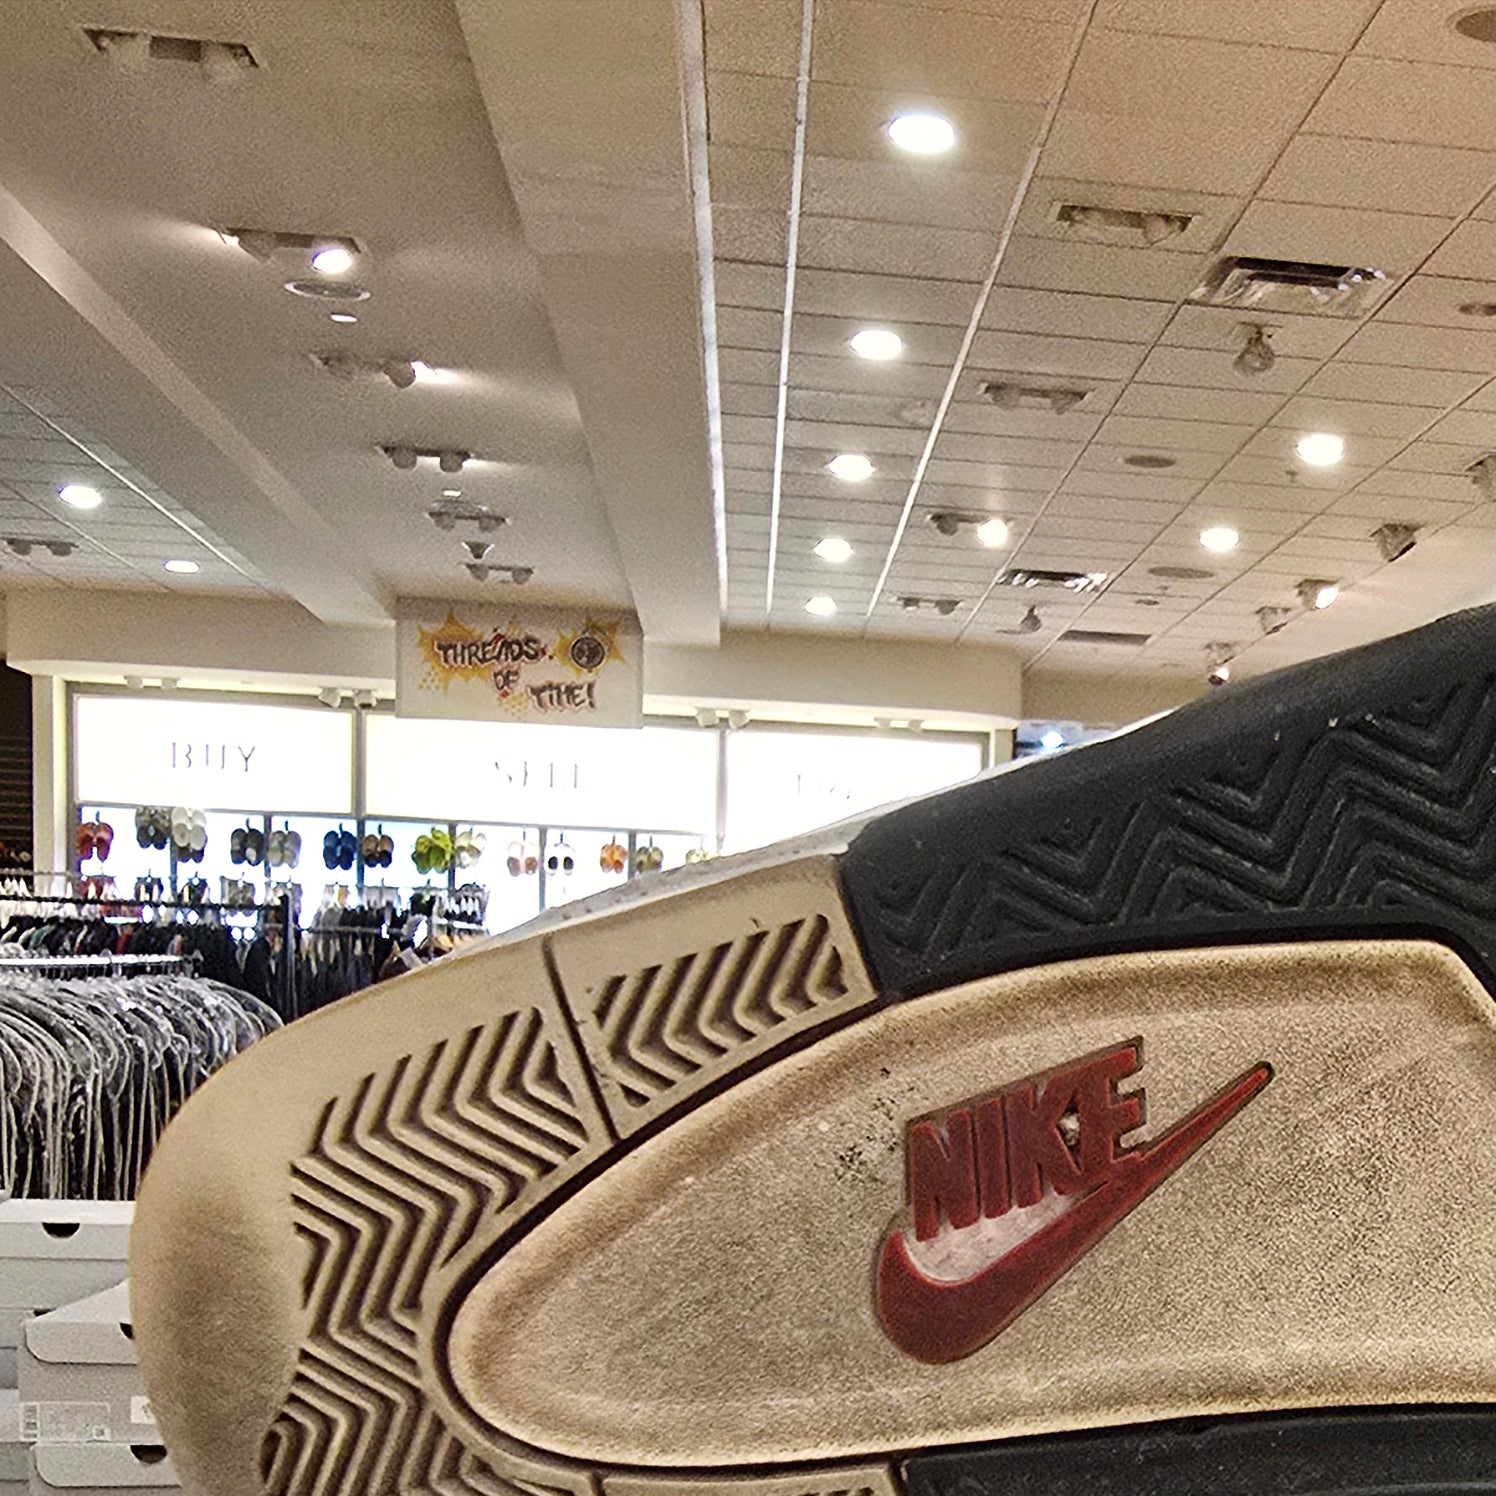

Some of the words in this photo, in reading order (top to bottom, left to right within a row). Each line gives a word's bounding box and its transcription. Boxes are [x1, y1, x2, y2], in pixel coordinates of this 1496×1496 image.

[435, 634, 540, 667] THREADS
[493, 669, 519, 691] OF
[171, 741, 256, 773] BUY
[905, 1036, 1146, 1243] NIKE
